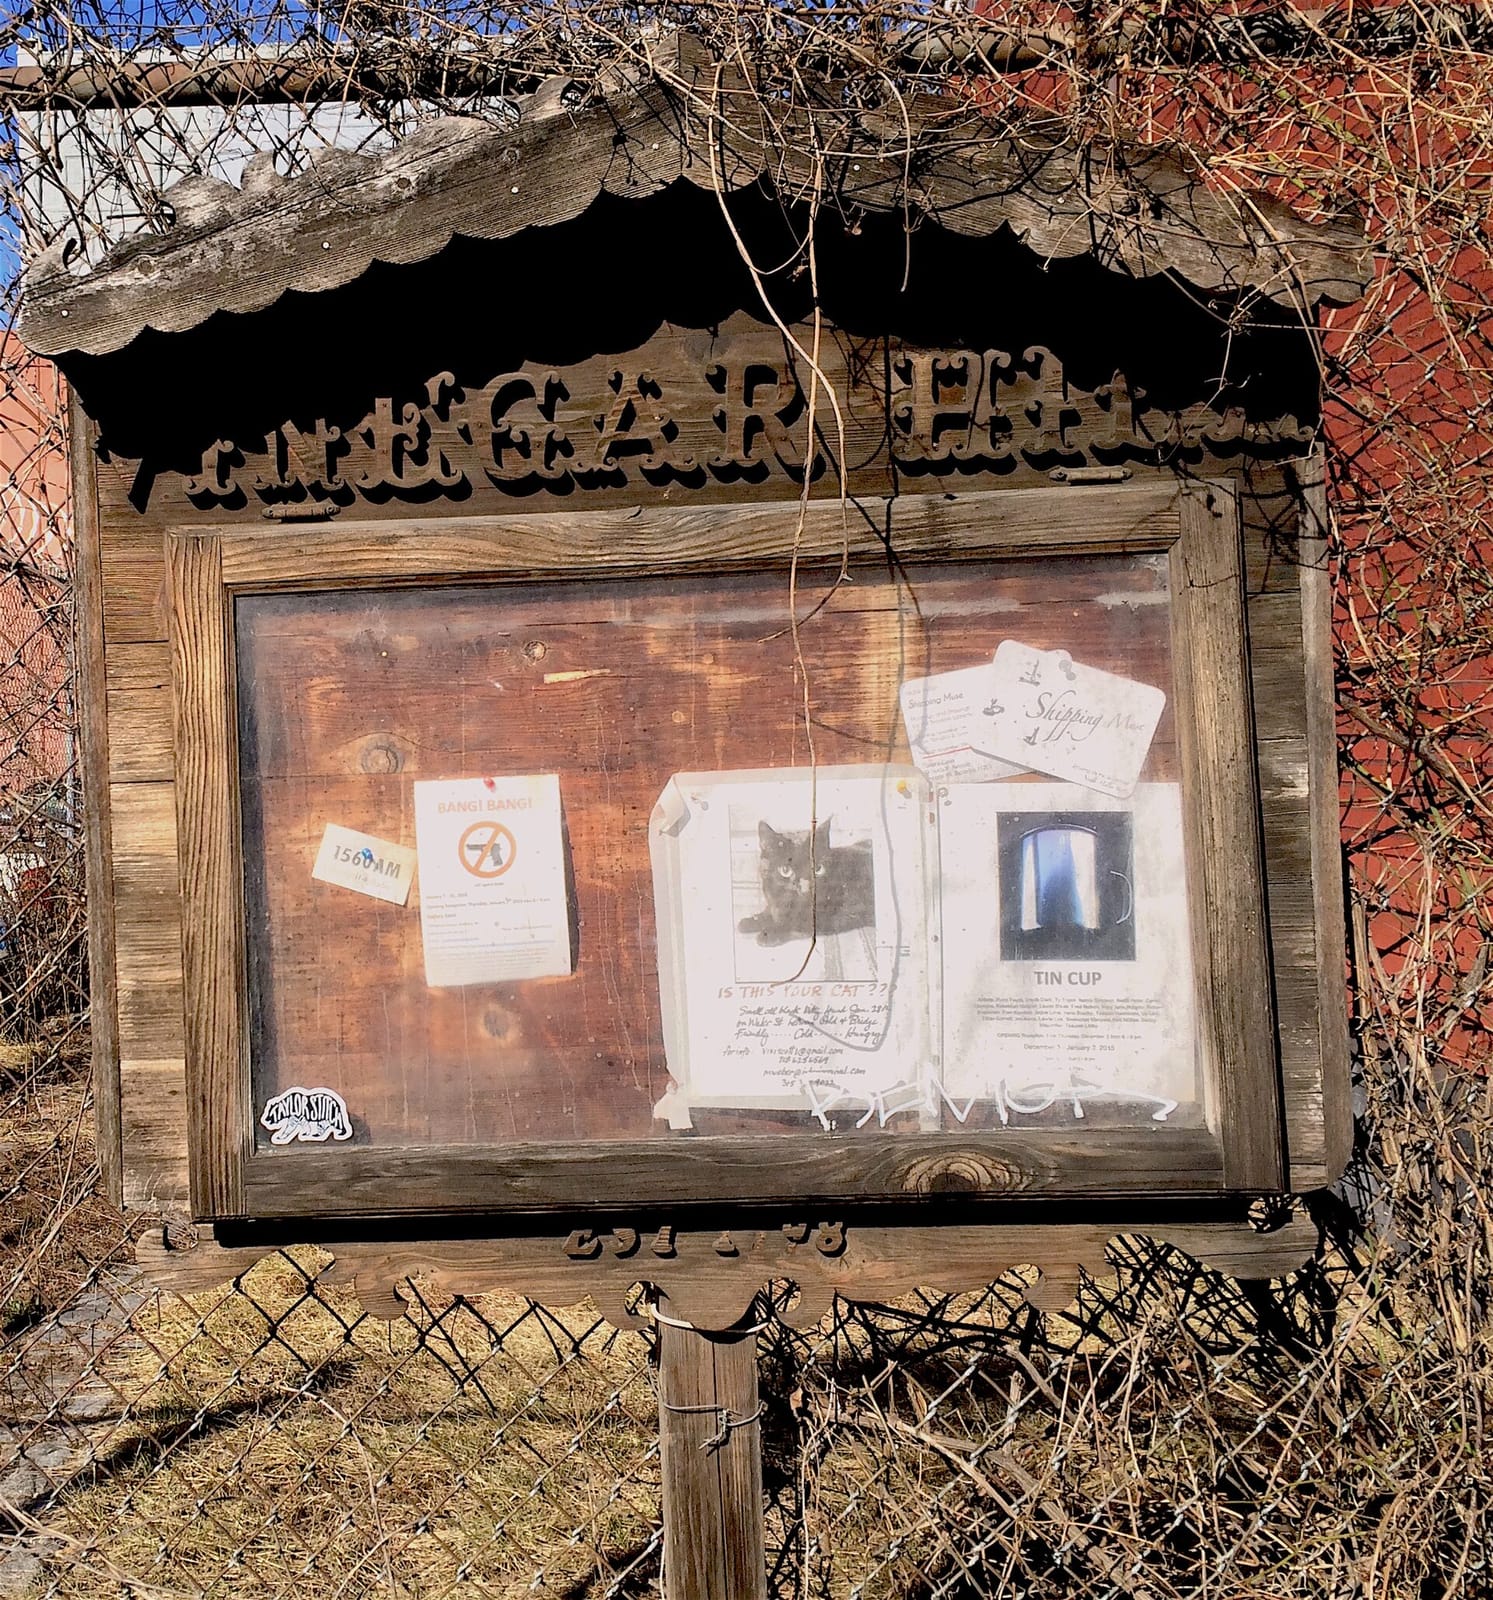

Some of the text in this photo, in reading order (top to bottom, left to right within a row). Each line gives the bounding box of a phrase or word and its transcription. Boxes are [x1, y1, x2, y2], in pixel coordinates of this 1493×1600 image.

[943, 691, 964, 702] Muse
[1025, 689, 1103, 743] Shipping
[437, 797, 533, 814] BANG! BANG!
[1033, 970, 1102, 986] TIN CUP
[717, 986, 733, 999] IS
[739, 985, 775, 999] THIS
[783, 984, 822, 998] YOUR
[830, 984, 863, 997] CAT
[269, 1093, 344, 1130] TAYLOR STITCH
